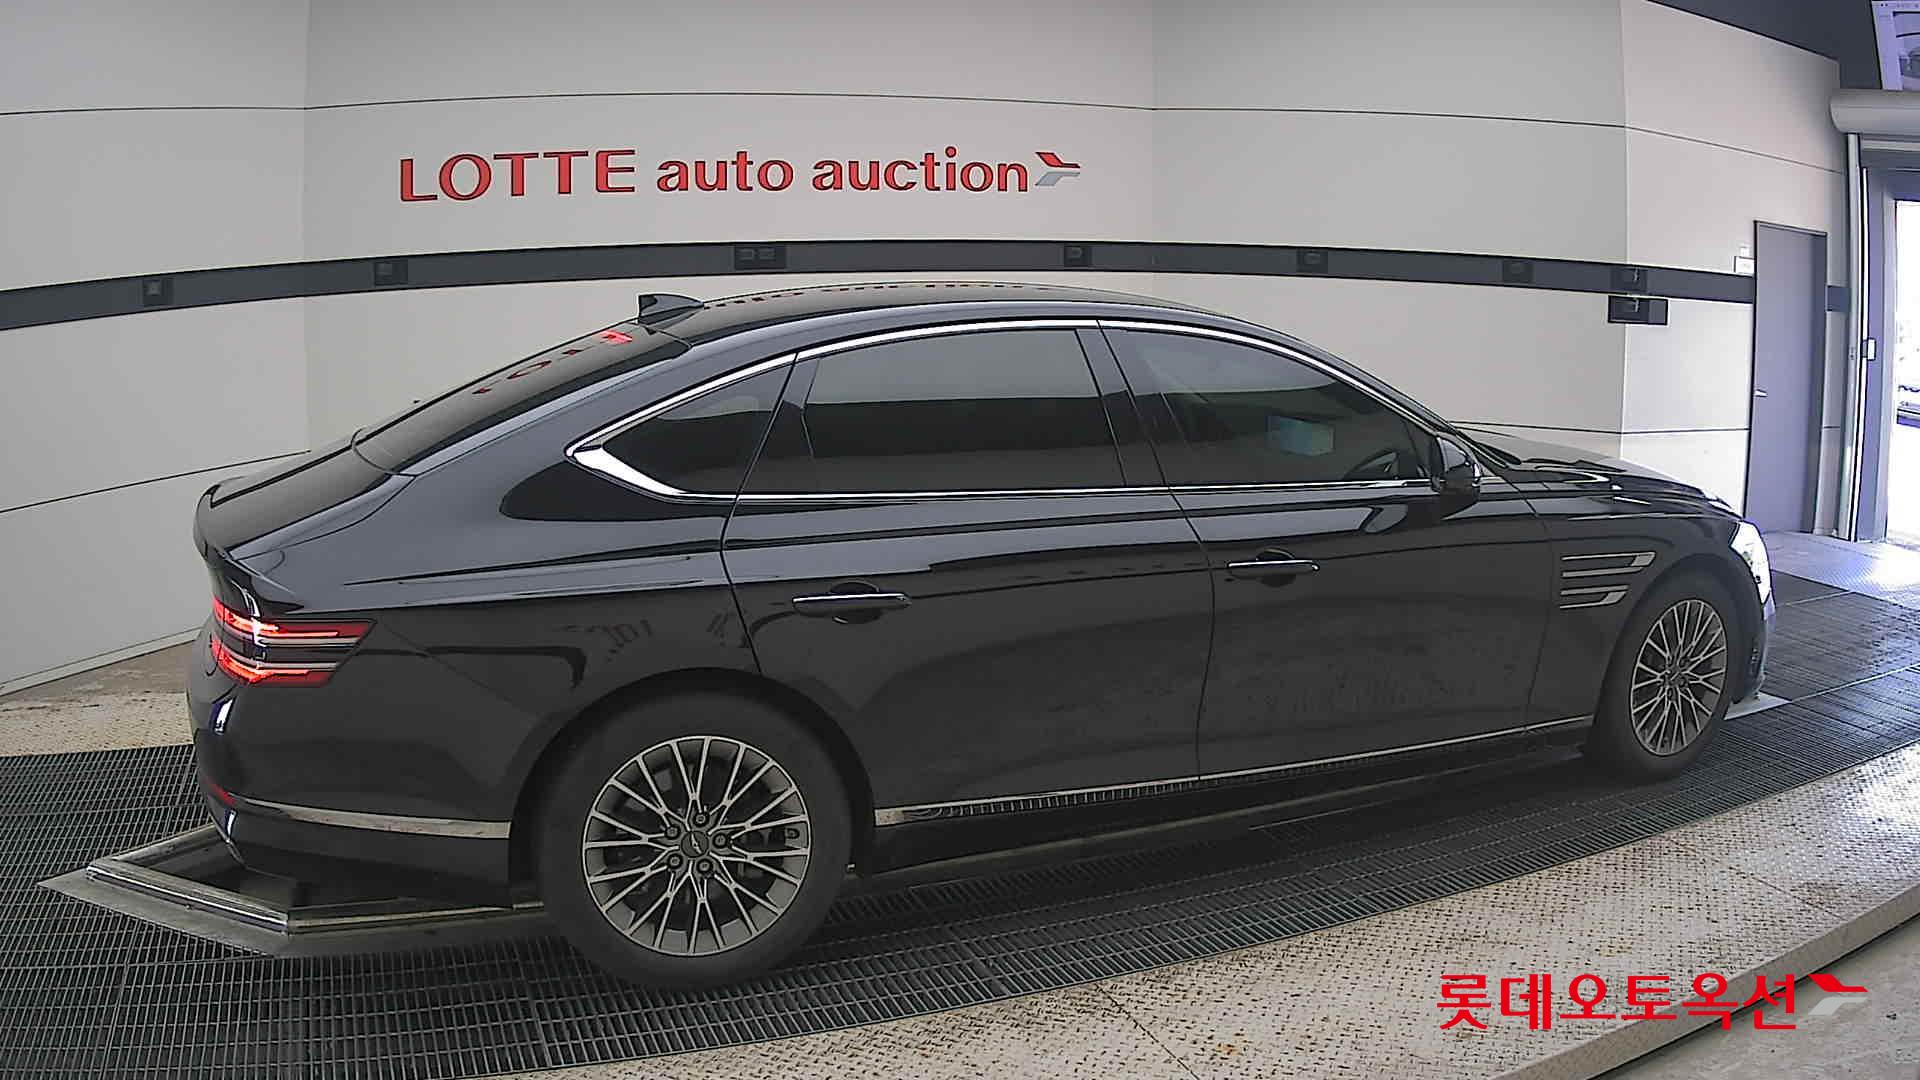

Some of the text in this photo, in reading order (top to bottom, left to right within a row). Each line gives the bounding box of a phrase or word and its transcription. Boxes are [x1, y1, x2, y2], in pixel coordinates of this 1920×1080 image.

[400, 146, 1029, 202] LOTTE auto auction
